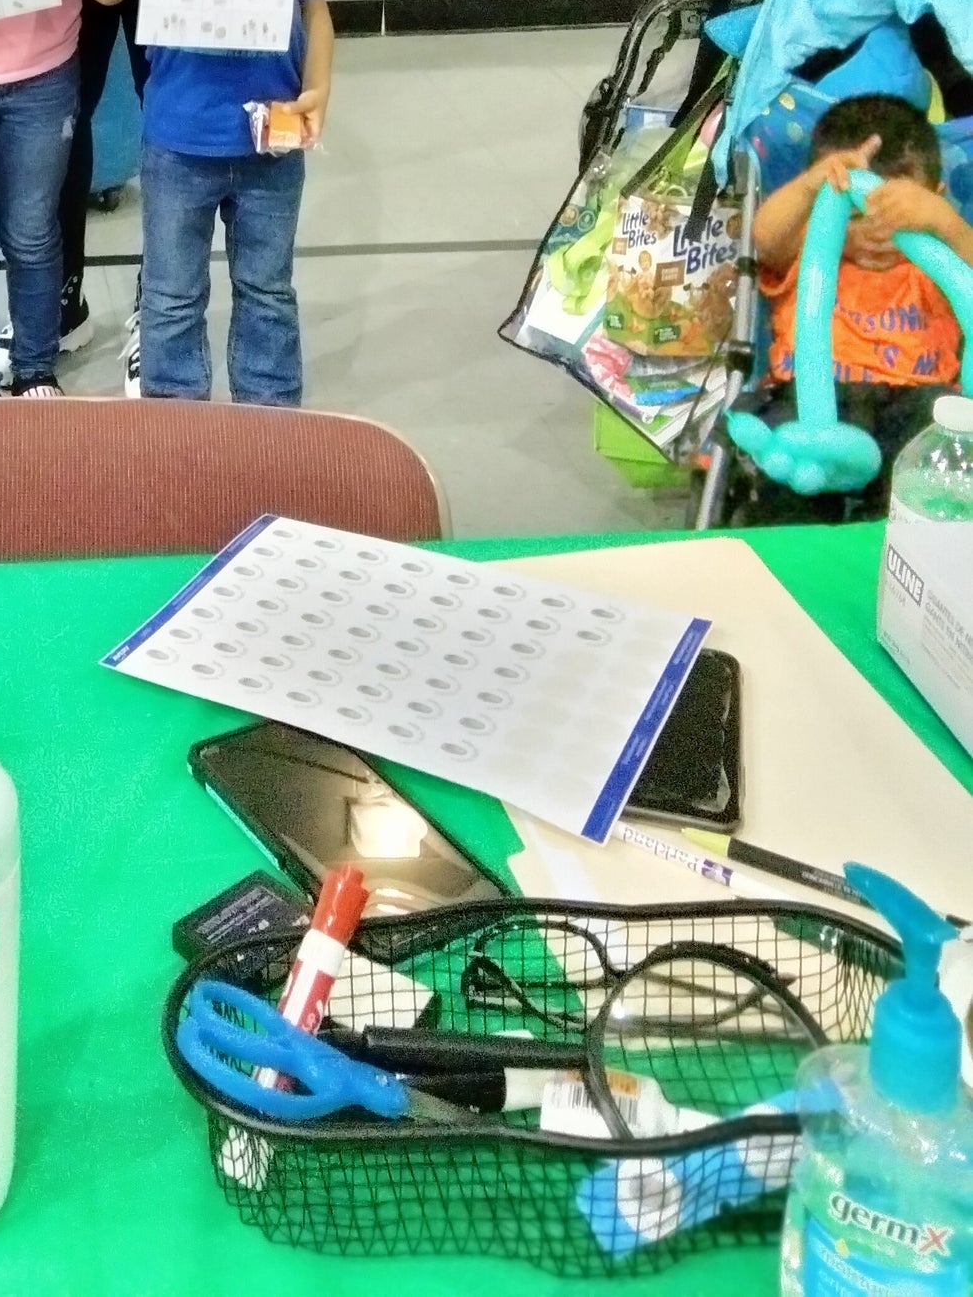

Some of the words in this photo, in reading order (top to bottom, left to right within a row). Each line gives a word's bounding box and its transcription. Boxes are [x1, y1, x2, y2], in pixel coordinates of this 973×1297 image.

[622, 210, 649, 235] Little
[627, 229, 657, 249] Bites
[686, 242, 738, 275] Bites
[886, 547, 923, 602] ULINE
[622, 827, 698, 872] Parkland
